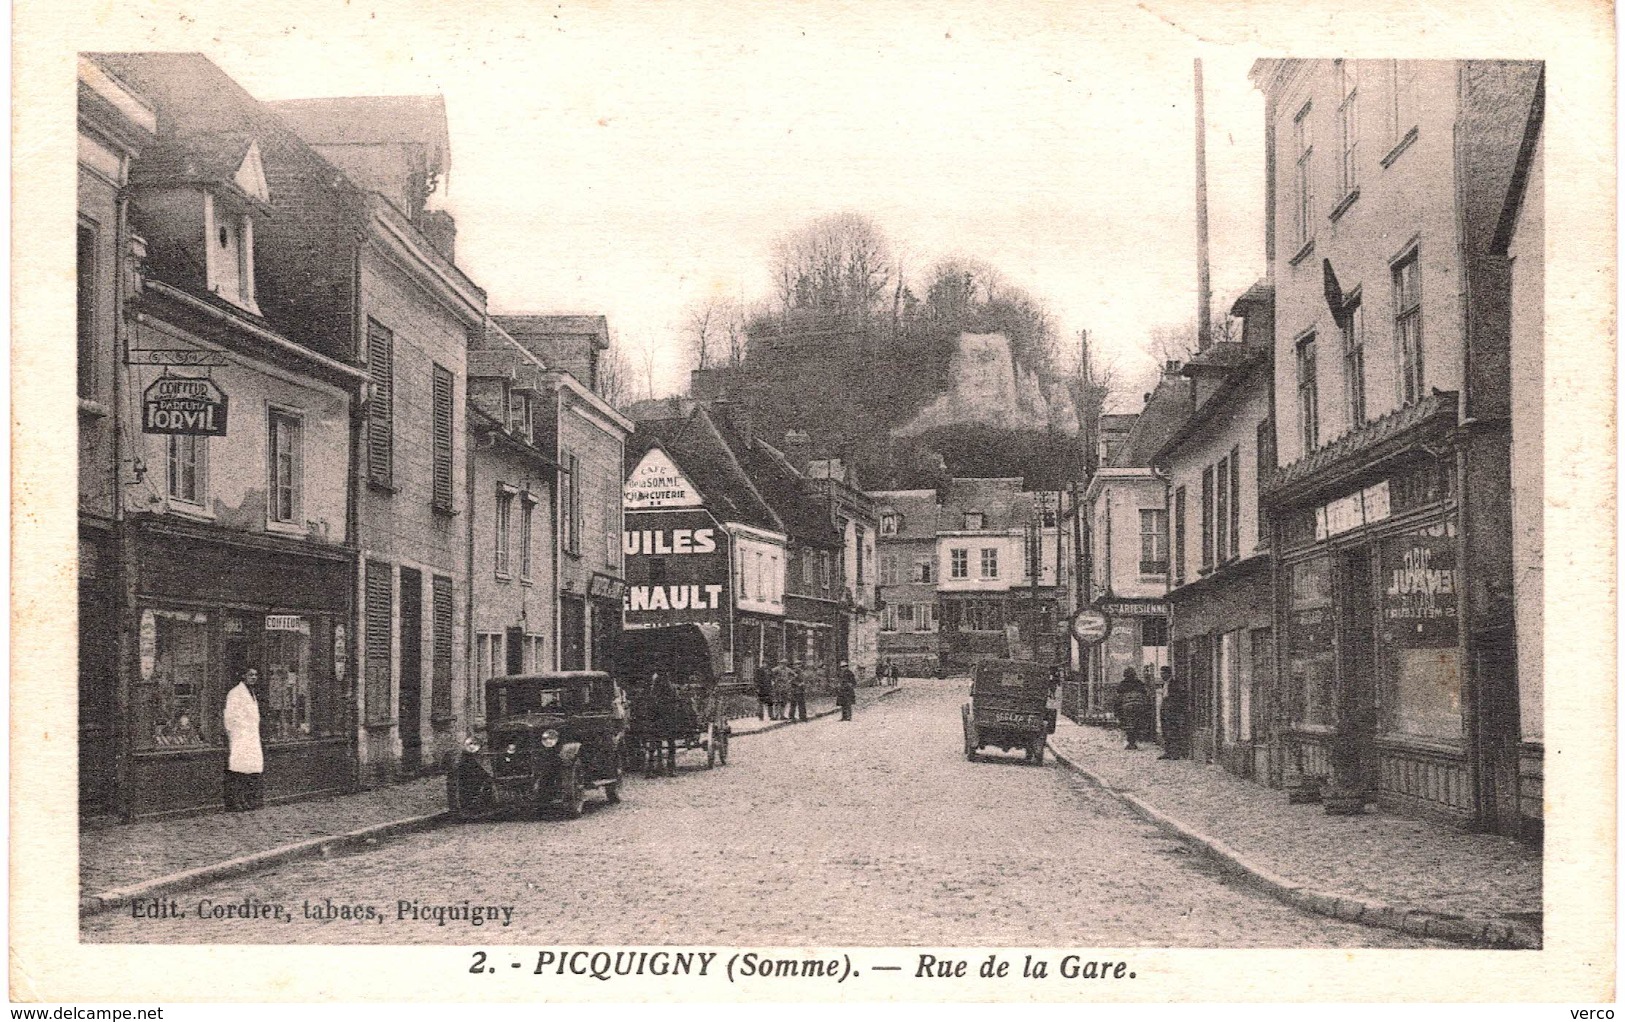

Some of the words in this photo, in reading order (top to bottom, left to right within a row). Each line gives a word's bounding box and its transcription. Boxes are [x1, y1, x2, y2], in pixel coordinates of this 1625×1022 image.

[148, 403, 218, 431] FORVIL
[647, 477, 680, 488] SOMME
[624, 529, 717, 555] UILES
[266, 617, 299, 628] COIFFEUR
